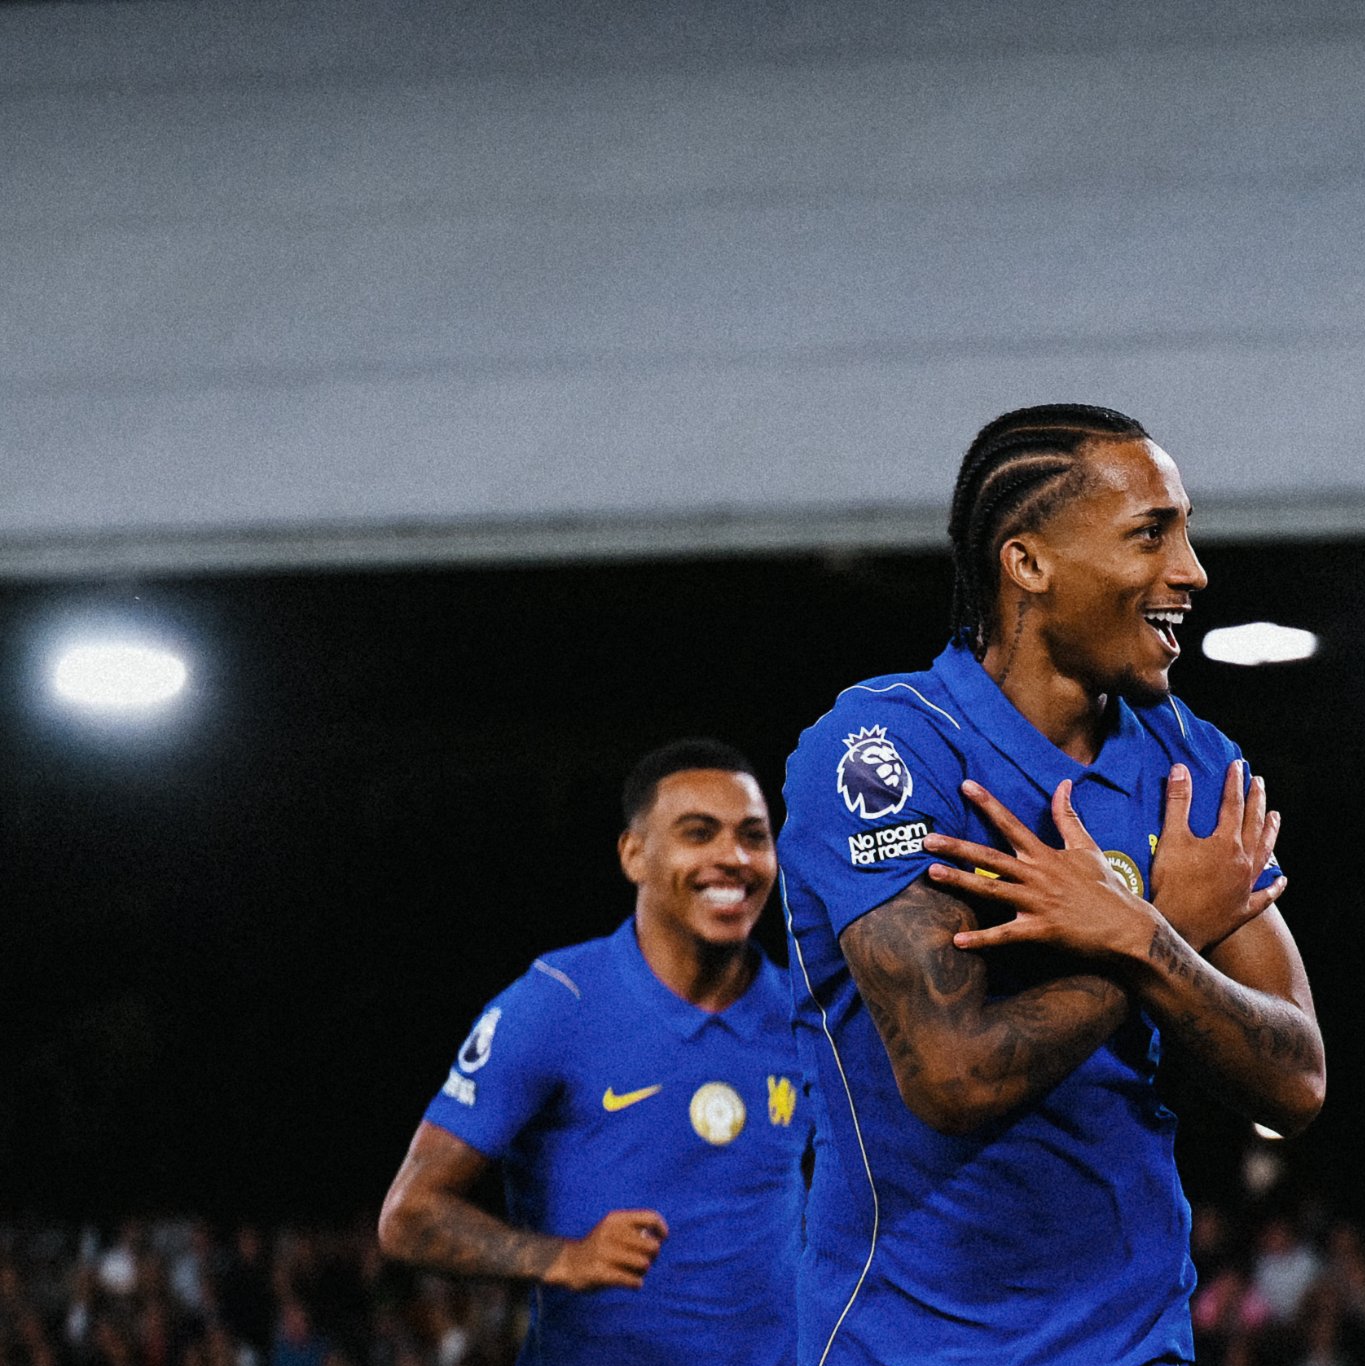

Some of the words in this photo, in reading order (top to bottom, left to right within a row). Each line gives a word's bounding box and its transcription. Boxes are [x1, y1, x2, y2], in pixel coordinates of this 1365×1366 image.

[848, 833, 875, 851] No
[876, 822, 928, 846] room
[850, 848, 877, 865] for
[878, 837, 924, 861] racis
[1107, 857, 1139, 895] HAMPION
